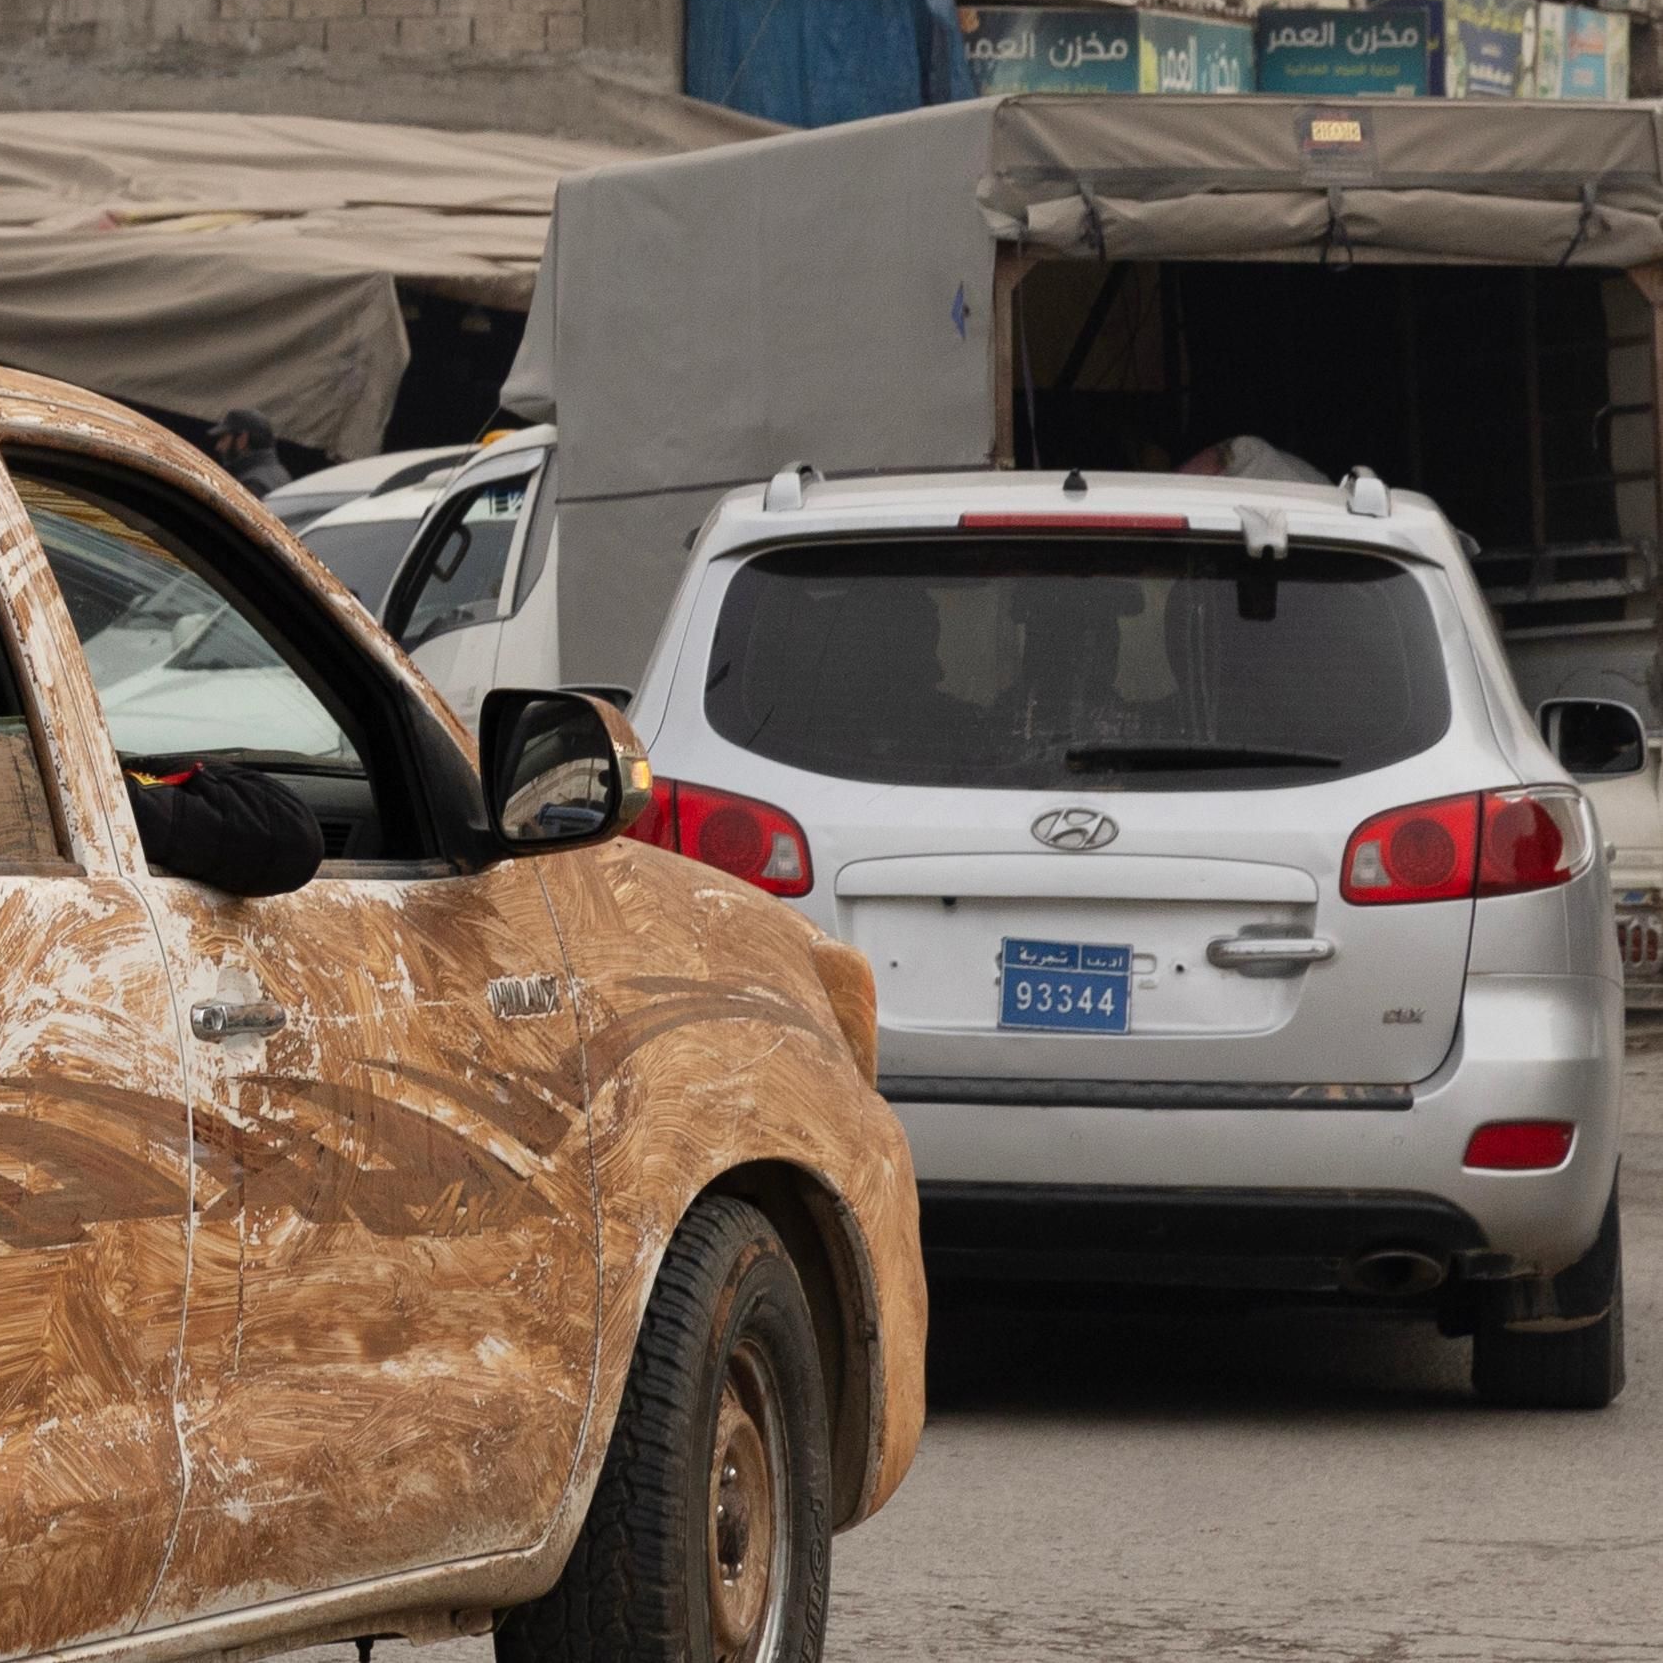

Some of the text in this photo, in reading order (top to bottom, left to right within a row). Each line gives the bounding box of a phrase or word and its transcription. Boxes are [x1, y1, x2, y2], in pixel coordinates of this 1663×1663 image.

[1048, 32, 1129, 69] مخزن
[1267, 21, 1419, 55] مخزن العمر
[1019, 945, 1069, 968] تجربة
[1016, 981, 1116, 1016] 93344
